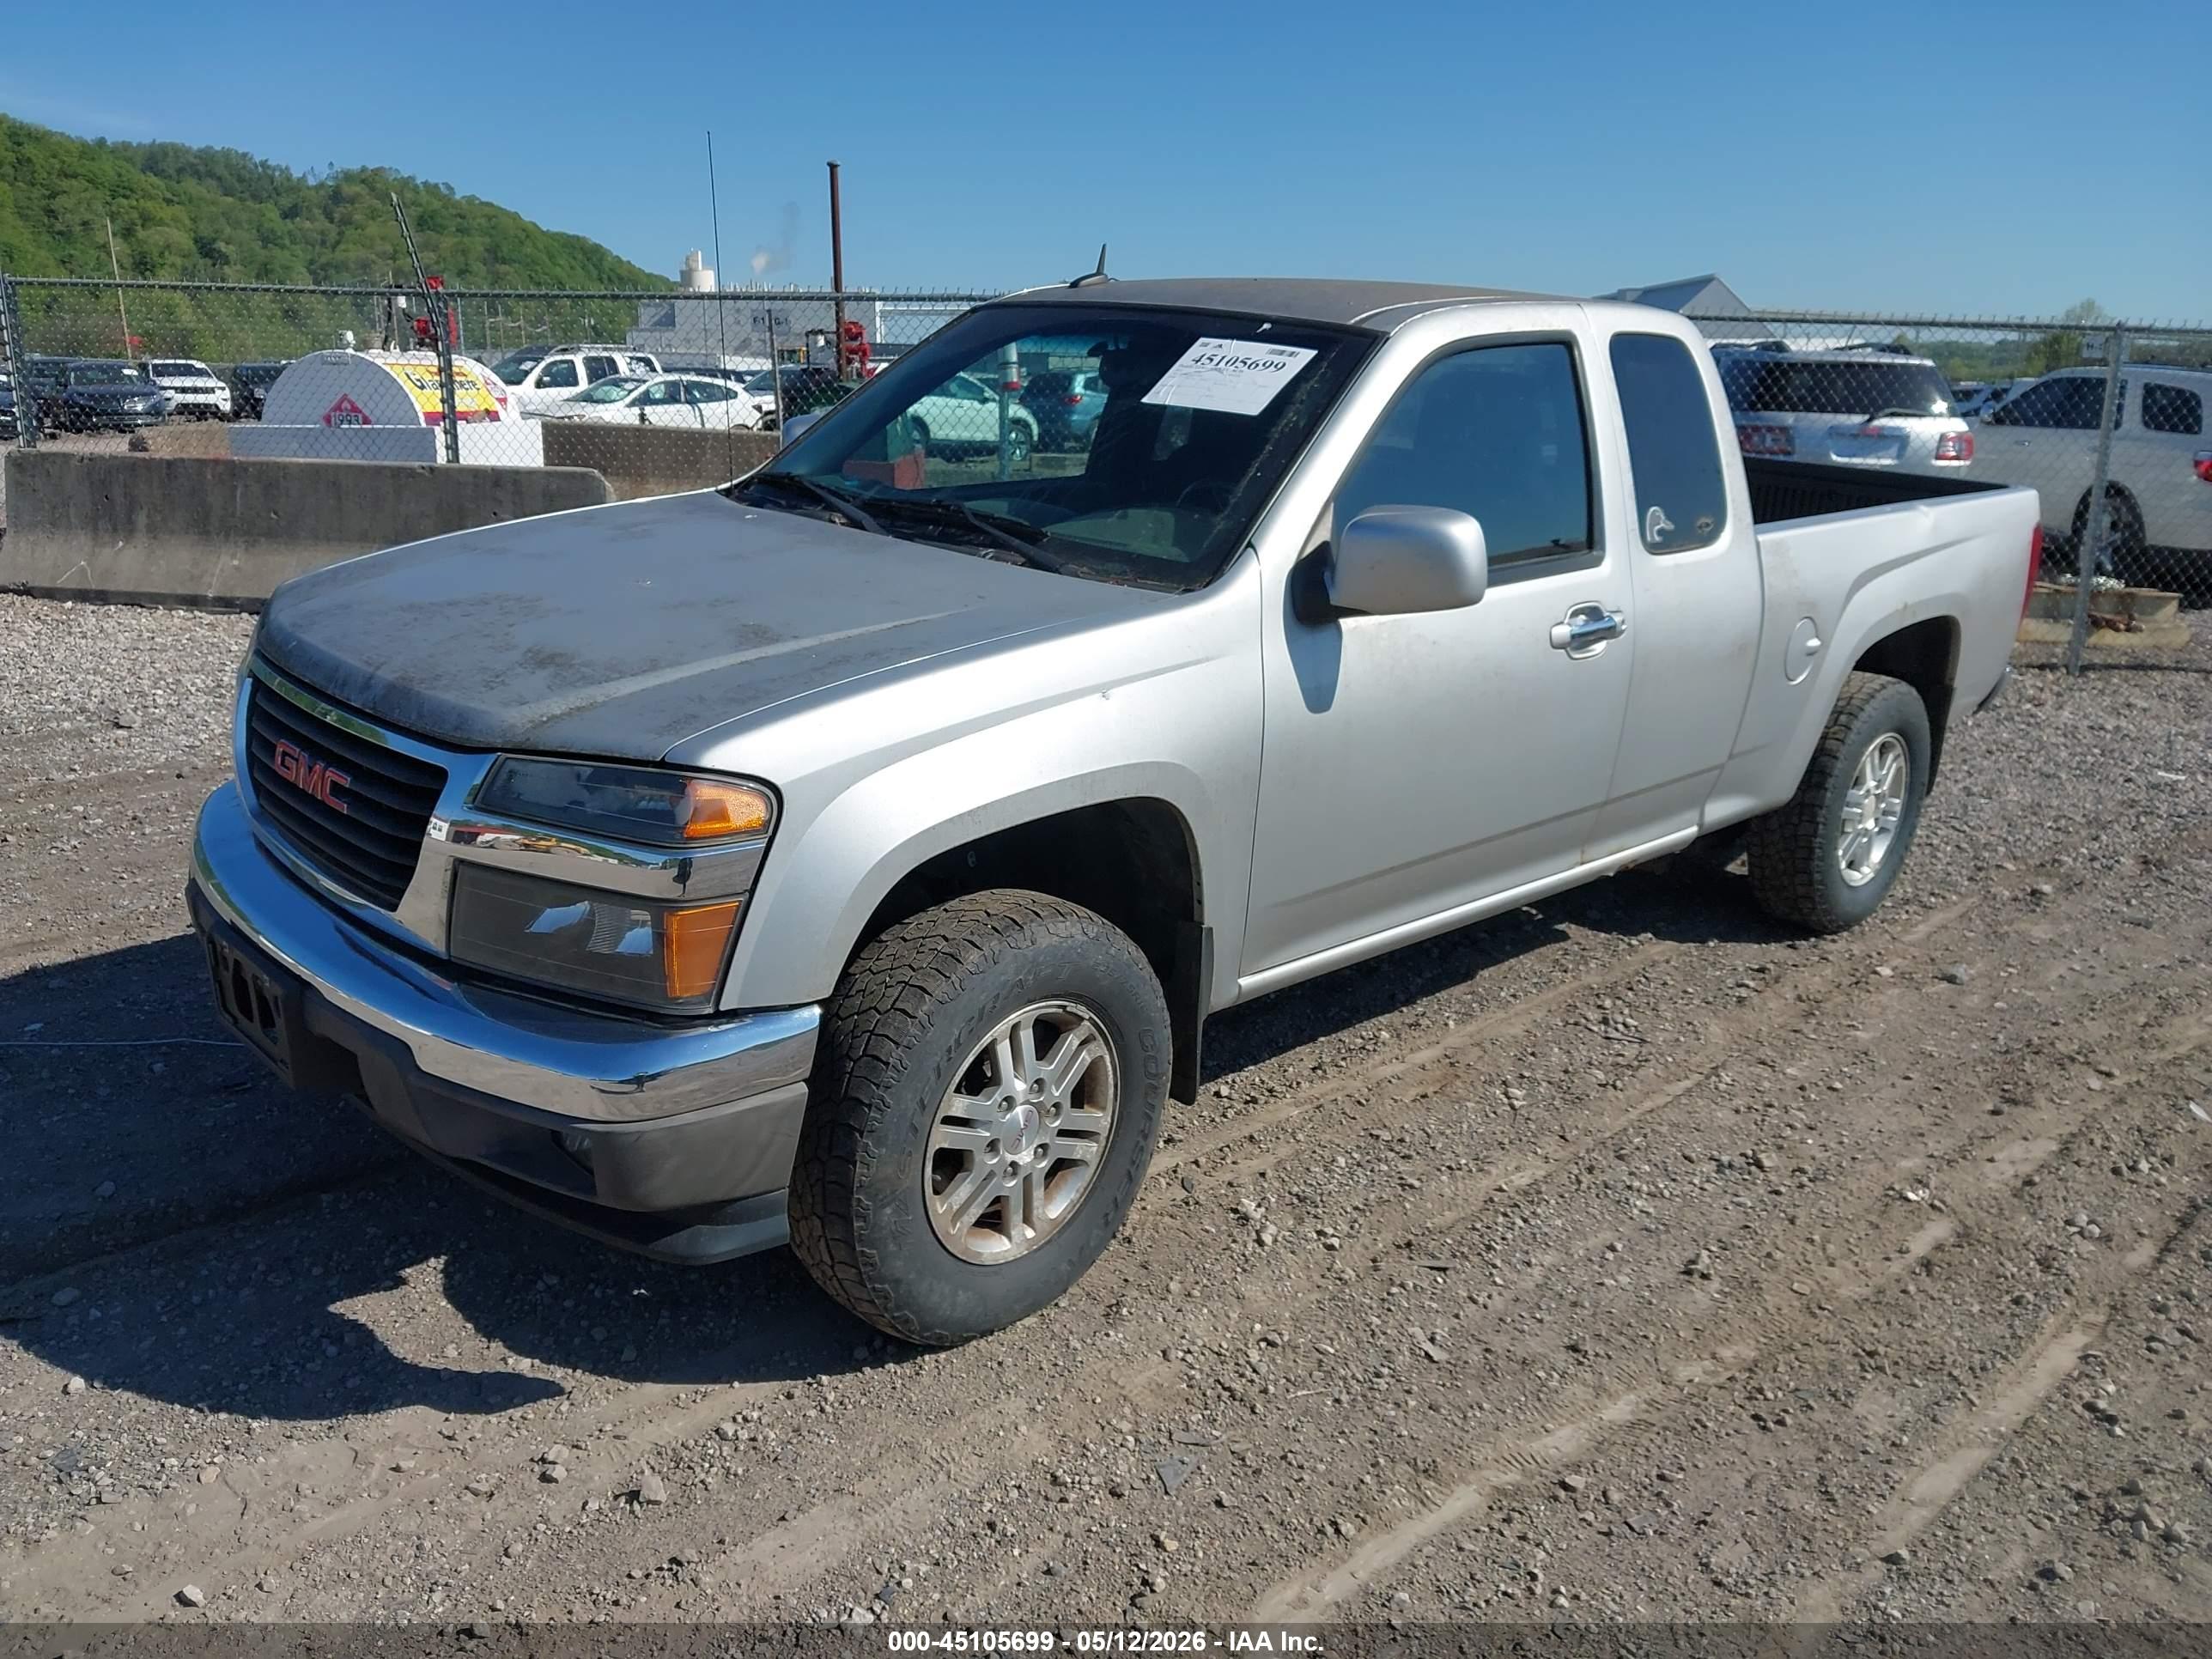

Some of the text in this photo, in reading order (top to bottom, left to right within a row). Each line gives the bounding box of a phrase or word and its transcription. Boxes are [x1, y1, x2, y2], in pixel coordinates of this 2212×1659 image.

[1191, 353, 1287, 373] 45105699
[333, 412, 361, 427] 1993
[276, 739, 350, 814] GMC
[1011, 1109, 1034, 1149] GMC
